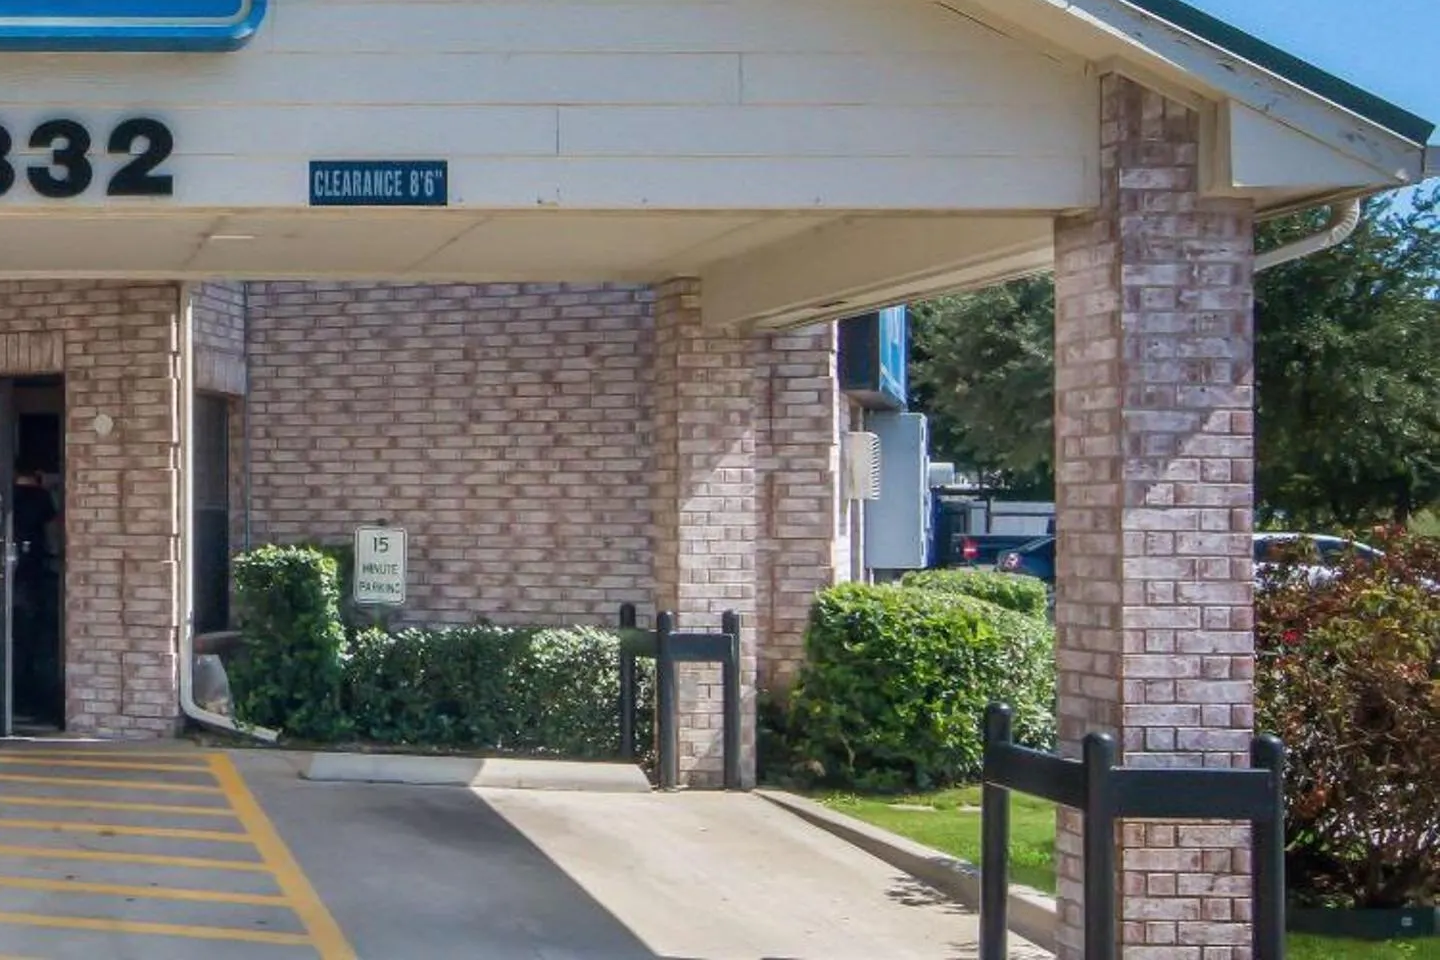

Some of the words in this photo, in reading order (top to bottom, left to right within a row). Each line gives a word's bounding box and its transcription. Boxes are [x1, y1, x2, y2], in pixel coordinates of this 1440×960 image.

[314, 170, 403, 197] CLEARANCE
[372, 536, 389, 553] 15
[362, 563, 398, 575] MINUTE
[359, 581, 400, 593] PARKING
